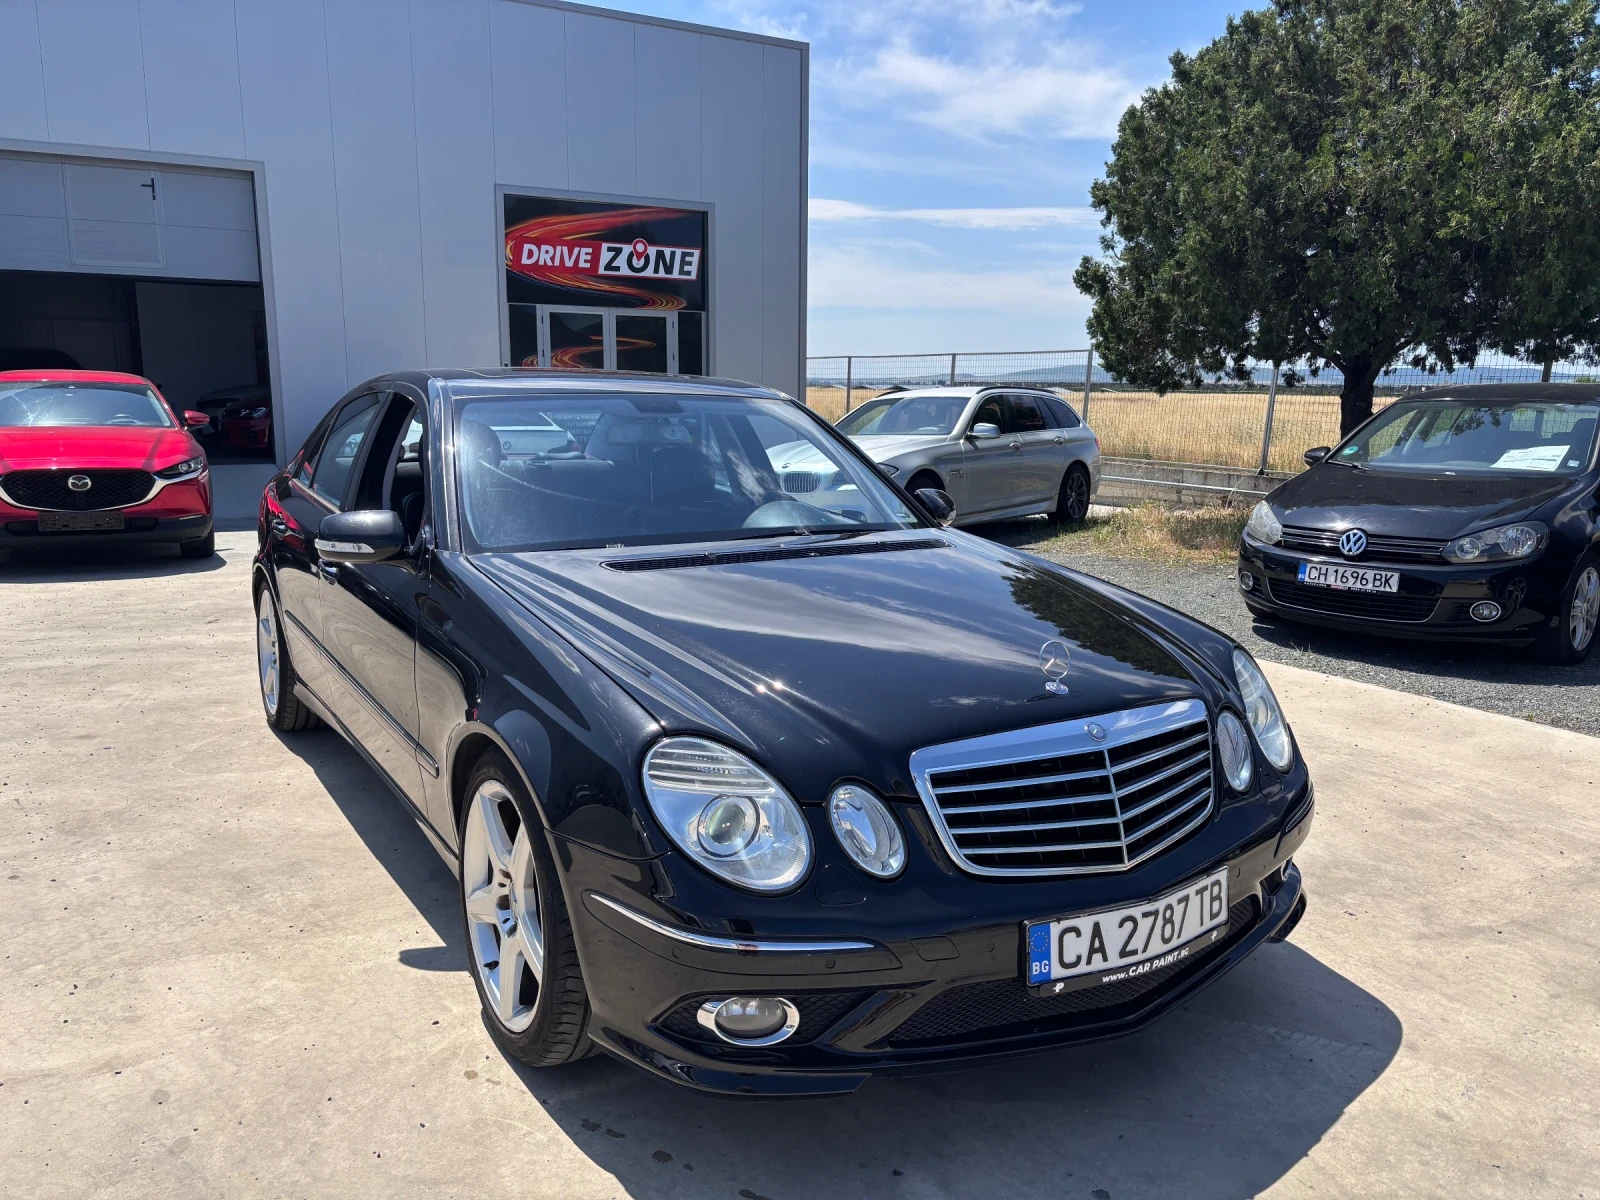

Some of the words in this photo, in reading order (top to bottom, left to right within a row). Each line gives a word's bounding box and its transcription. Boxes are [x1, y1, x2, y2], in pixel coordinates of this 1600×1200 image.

[521, 243, 593, 269] DRIVE
[603, 245, 695, 277] ZONE
[1308, 566, 1329, 582] CH
[1333, 568, 1369, 586] 1696
[1372, 572, 1395, 590] BK
[1058, 921, 1108, 970] CA
[1118, 894, 1190, 960] 2787
[1195, 879, 1222, 927] TB
[1032, 960, 1049, 975] BG
[1129, 962, 1151, 977] CAR
